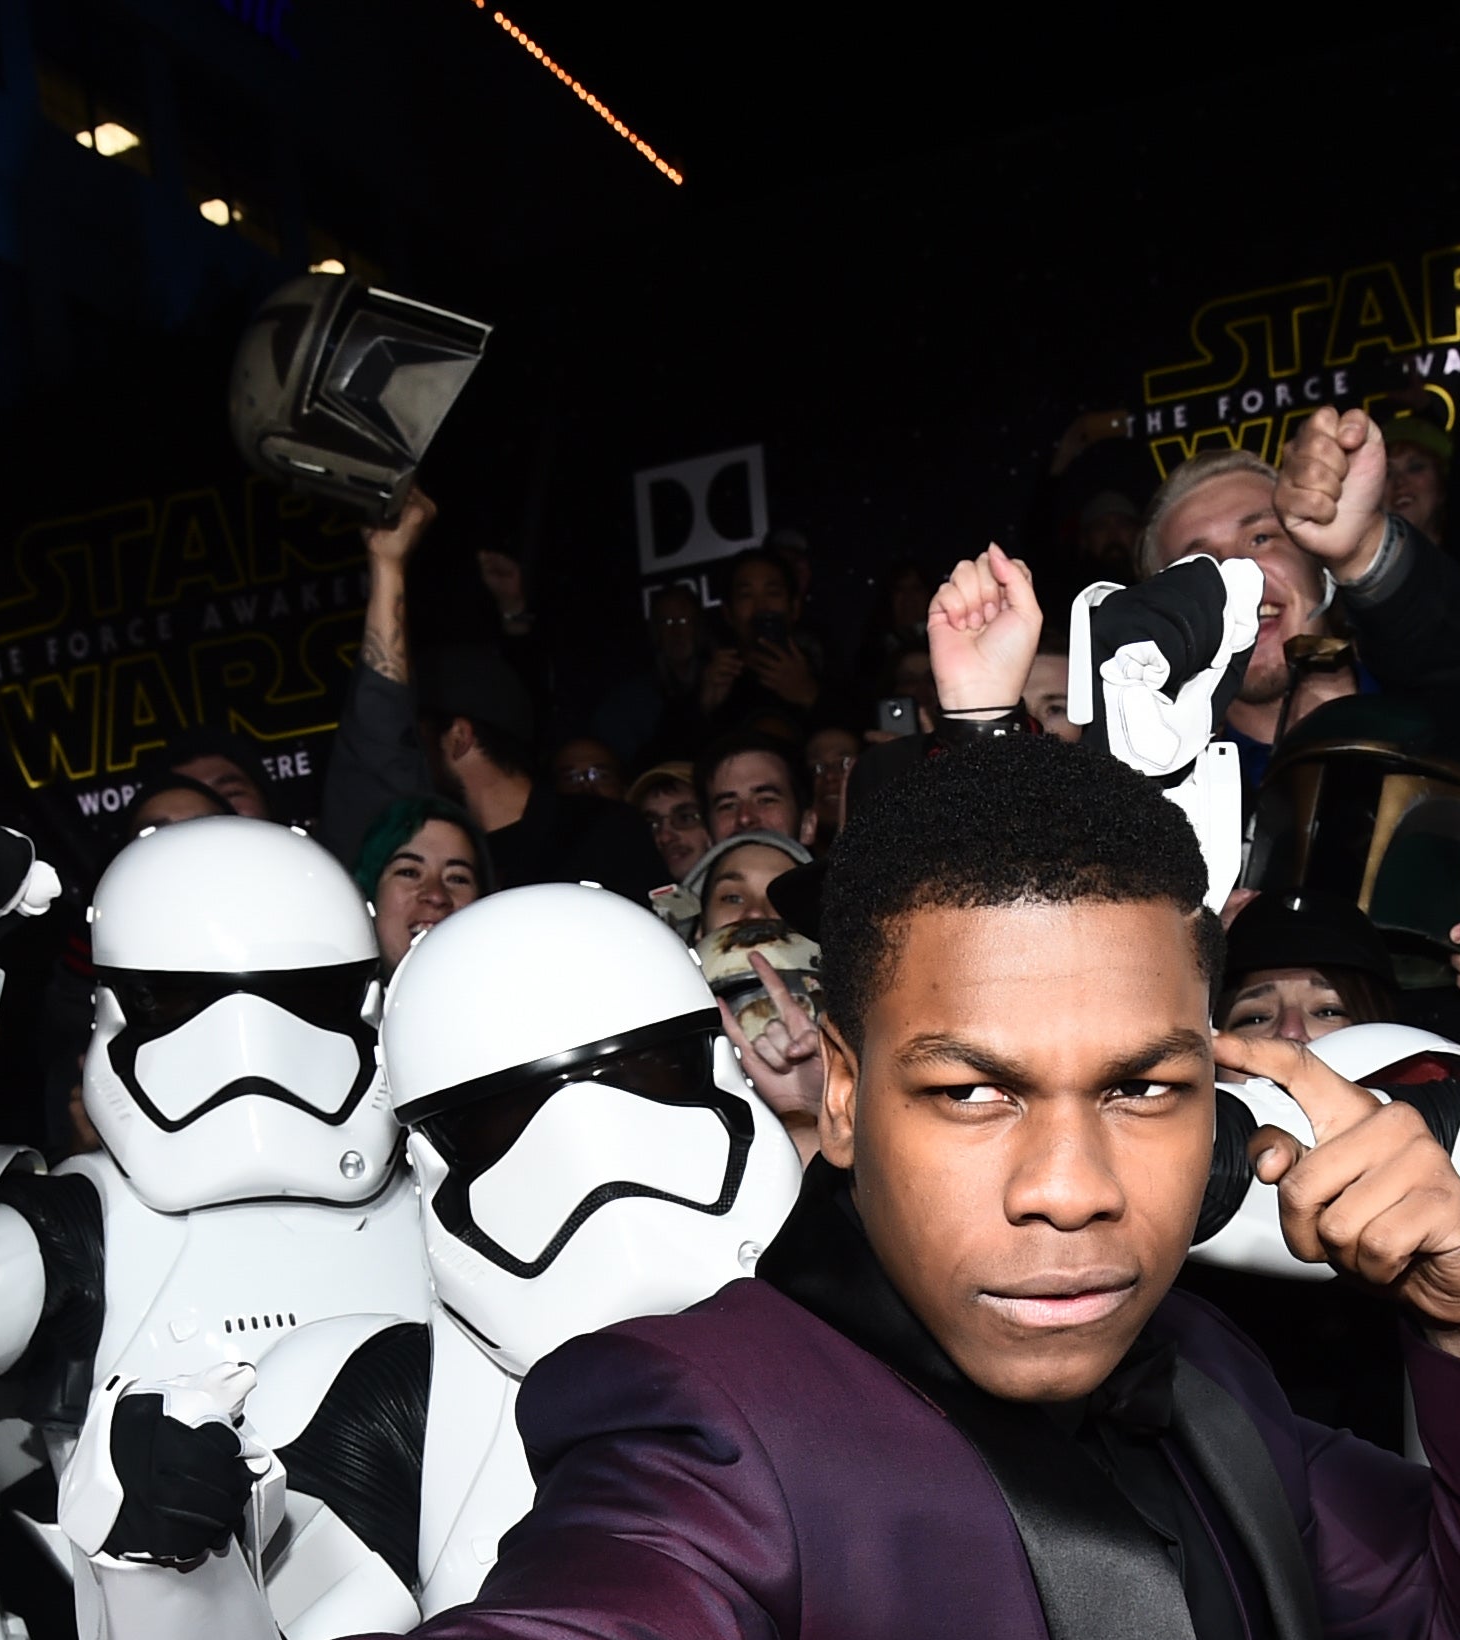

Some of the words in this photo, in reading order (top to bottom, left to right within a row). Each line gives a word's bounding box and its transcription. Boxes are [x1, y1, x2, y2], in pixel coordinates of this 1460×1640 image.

[1123, 404, 1188, 439] THE
[1217, 371, 1350, 420] FORCE
[44, 611, 174, 666] FORCE
